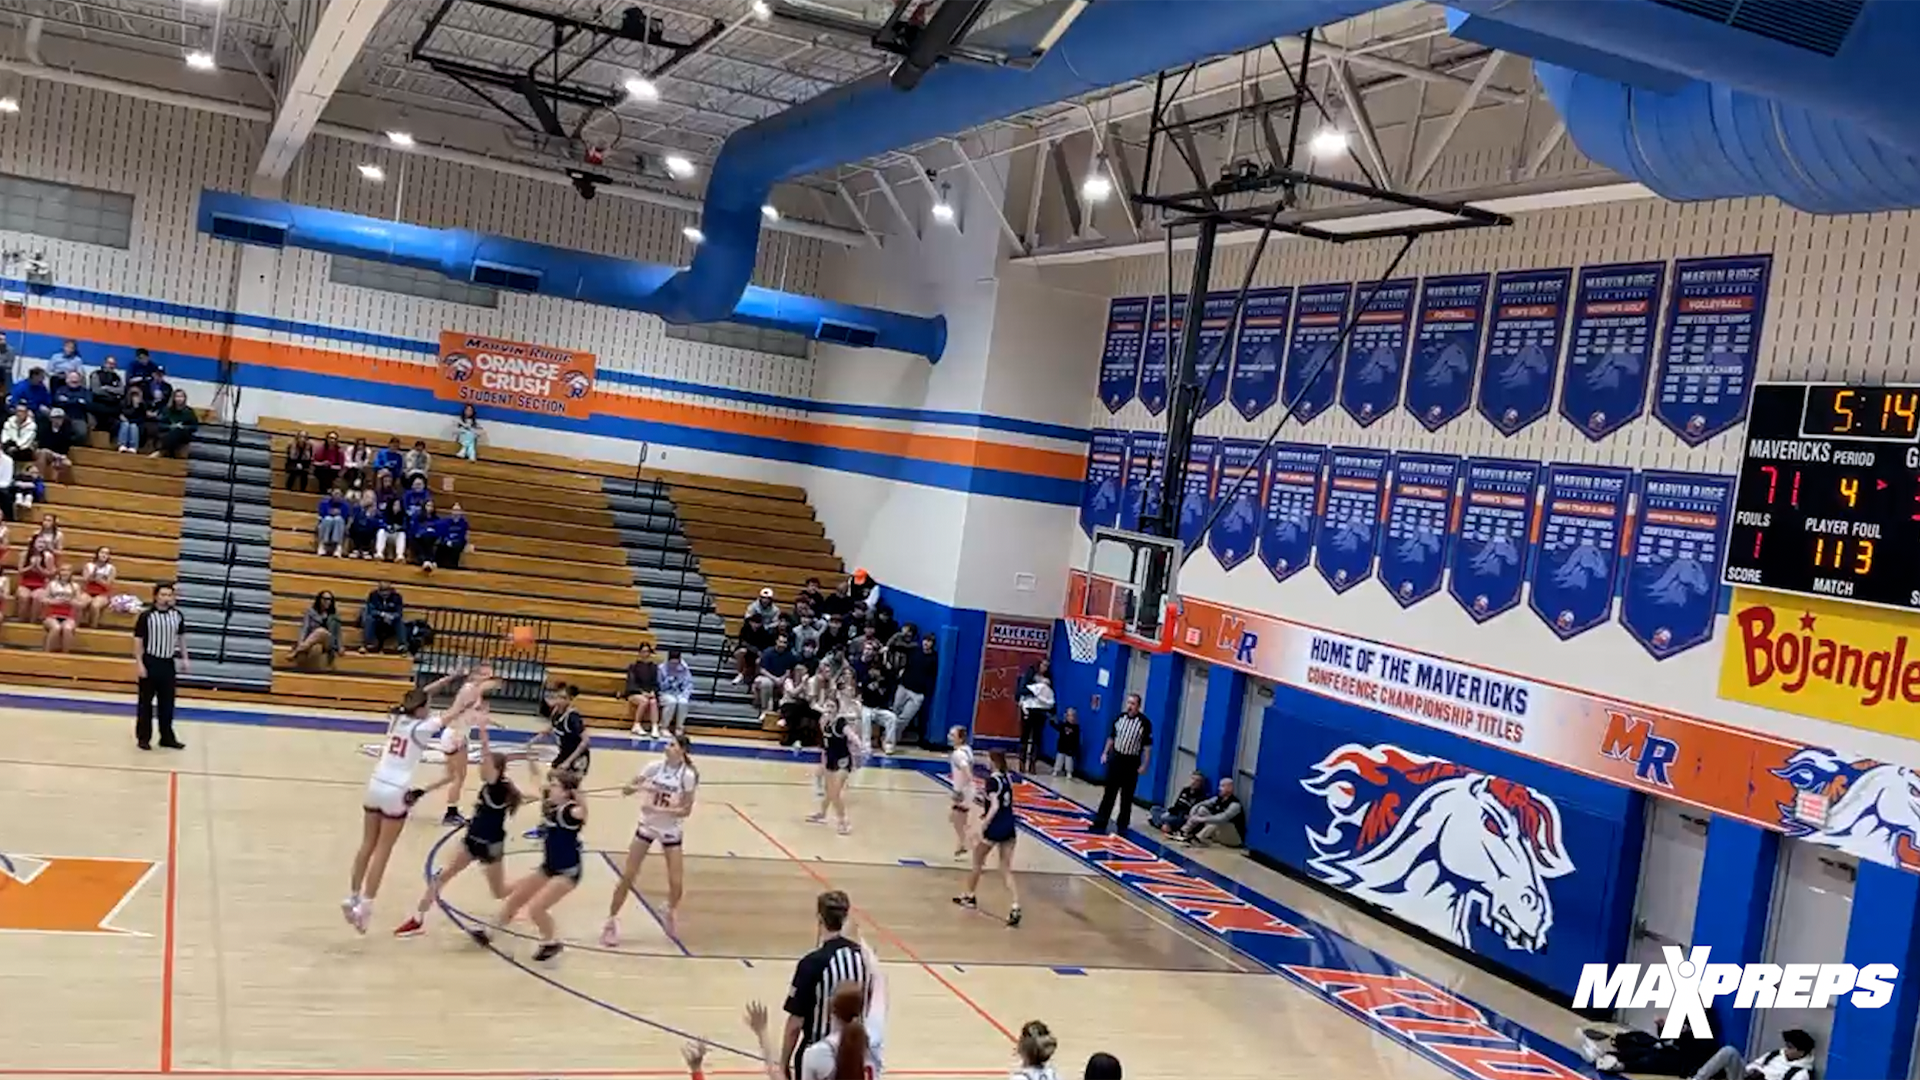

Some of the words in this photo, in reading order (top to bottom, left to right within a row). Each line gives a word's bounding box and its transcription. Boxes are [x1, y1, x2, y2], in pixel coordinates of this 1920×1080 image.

[1682, 270, 1725, 282] MARVIN
[1728, 268, 1762, 282] RIDGE
[1688, 299, 1742, 309] VOLLEYBALL
[465, 338, 524, 356] MARVIN
[528, 348, 573, 364] RIDGE
[475, 353, 561, 382] ORANGE
[482, 372, 550, 396] CRUSH
[458, 386, 515, 406] STUDENT
[517, 394, 567, 414] SECTION
[1833, 390, 1918, 432] 5:14
[1750, 438, 1832, 462] MAVERICKS
[1832, 450, 1875, 467] PERIOD
[1647, 482, 1691, 497] MARVIN
[1692, 486, 1726, 499] RIDGE
[1760, 465, 1802, 506] 71
[1840, 477, 1859, 508] 4
[1736, 511, 1772, 528] FOULS
[1805, 518, 1848, 535] PLAYER
[1852, 522, 1882, 539] FOUL
[1753, 531, 1763, 559] 1
[1728, 566, 1762, 583] SCORE
[1813, 578, 1854, 596] MATCH
[991, 624, 1049, 641] MAVERICKS
[1217, 613, 1259, 668] MR
[1310, 637, 1354, 669] HOME
[1356, 649, 1376, 673] OF
[1380, 653, 1410, 684] THE
[1415, 664, 1529, 715] MAVERICKS
[1307, 666, 1378, 703] CONFERENCE
[1380, 687, 1475, 728] CHAMPIONSHIP
[1476, 712, 1524, 744] TITLES
[388, 737, 408, 759] 21
[1598, 708, 1680, 790] MR
